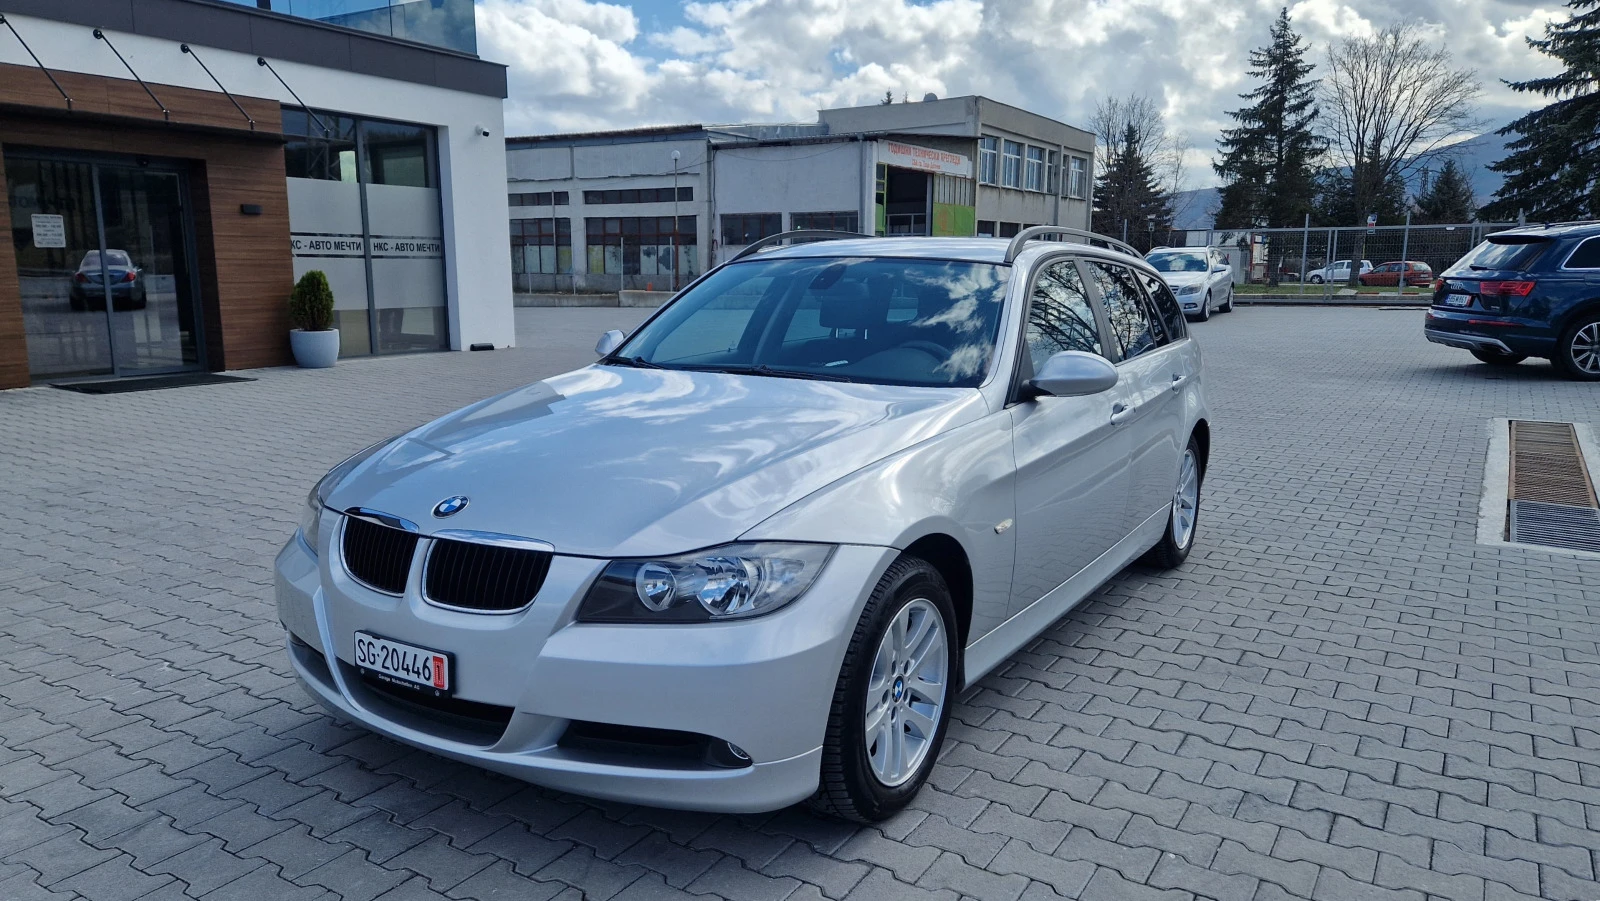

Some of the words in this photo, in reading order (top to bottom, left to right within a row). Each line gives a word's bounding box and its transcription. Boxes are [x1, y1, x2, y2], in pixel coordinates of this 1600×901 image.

[291, 240, 301, 249] КС
[309, 240, 331, 250] АВТО
[334, 242, 361, 251] МЕЧТИ
[373, 242, 389, 252] НКС
[394, 243, 415, 252] АВТО
[416, 243, 440, 253] МЕЧТИ
